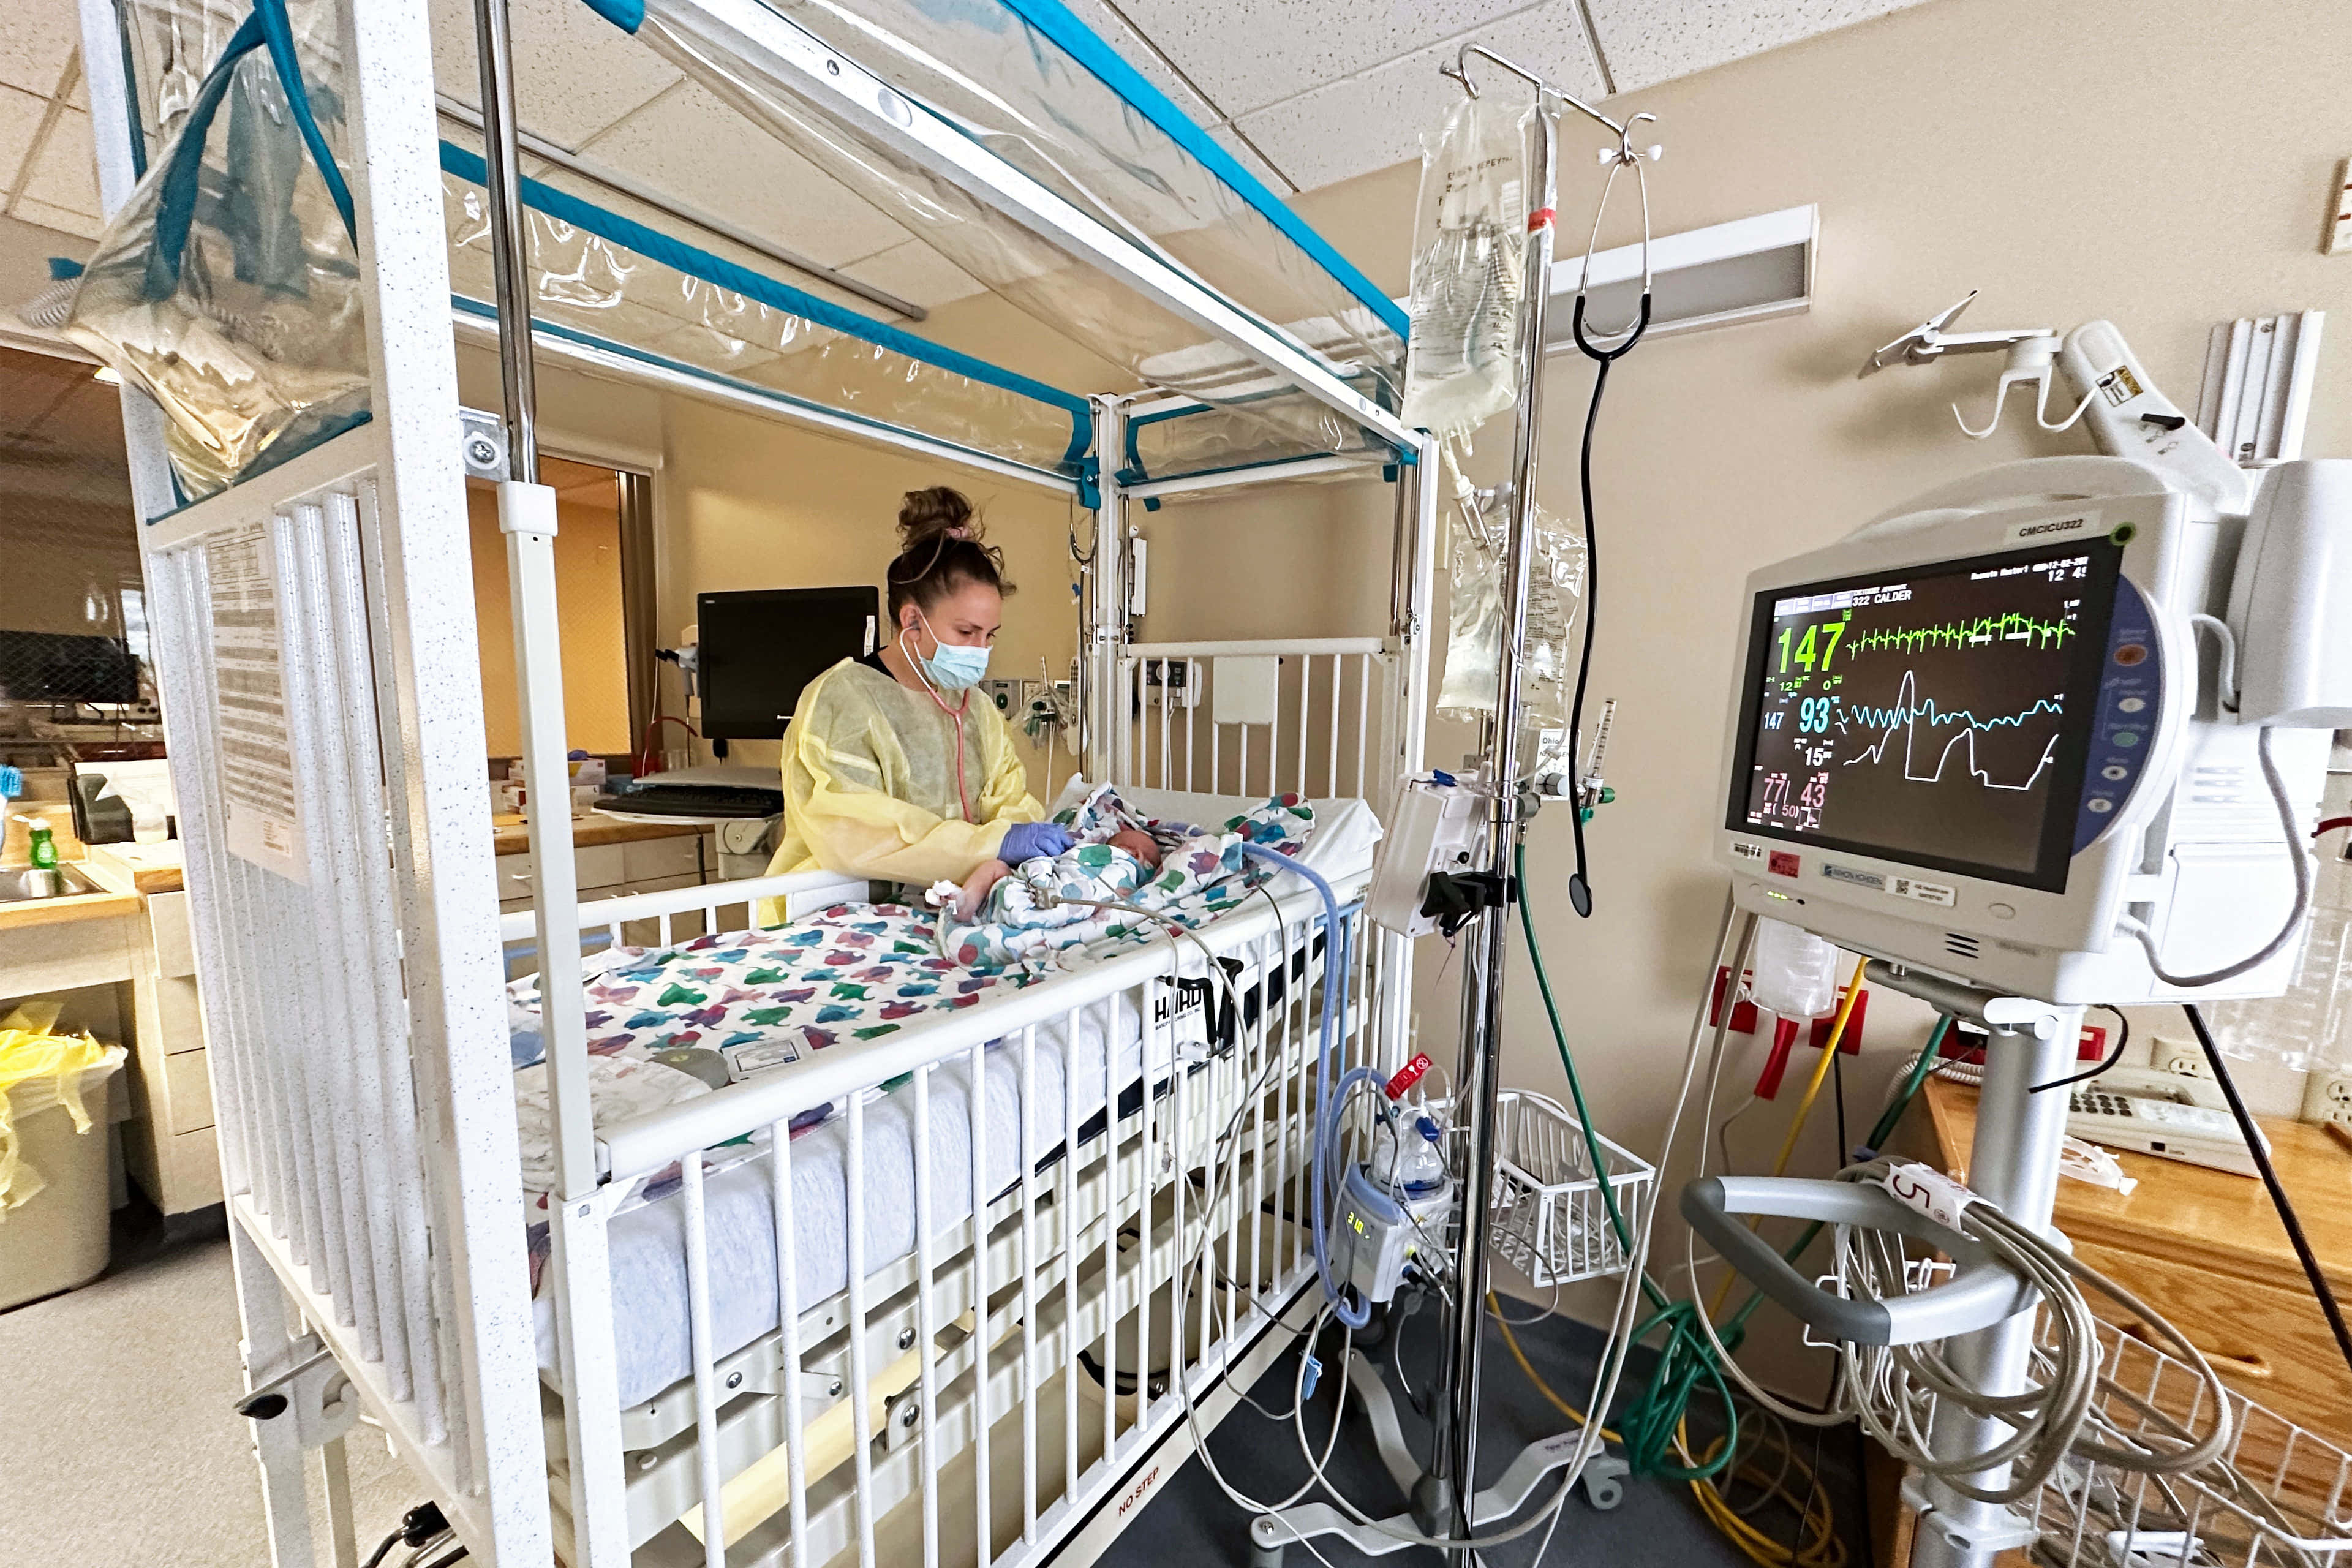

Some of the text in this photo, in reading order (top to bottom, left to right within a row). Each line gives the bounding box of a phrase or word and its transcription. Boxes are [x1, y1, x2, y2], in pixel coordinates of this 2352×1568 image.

[2019, 519, 2084, 537] CMCICU322
[2048, 569, 2065, 582] 12
[1852, 597, 1870, 607] 322
[1874, 590, 1912, 603] CALDER
[1778, 622, 1845, 673] 147
[1765, 712, 1784, 730] 147
[1799, 696, 1830, 733] 93
[1805, 747, 1824, 766] 15
[1800, 783, 1826, 808] 43
[1893, 1174, 1930, 1209] 5
[1118, 1466, 1159, 1517] NO STEP
